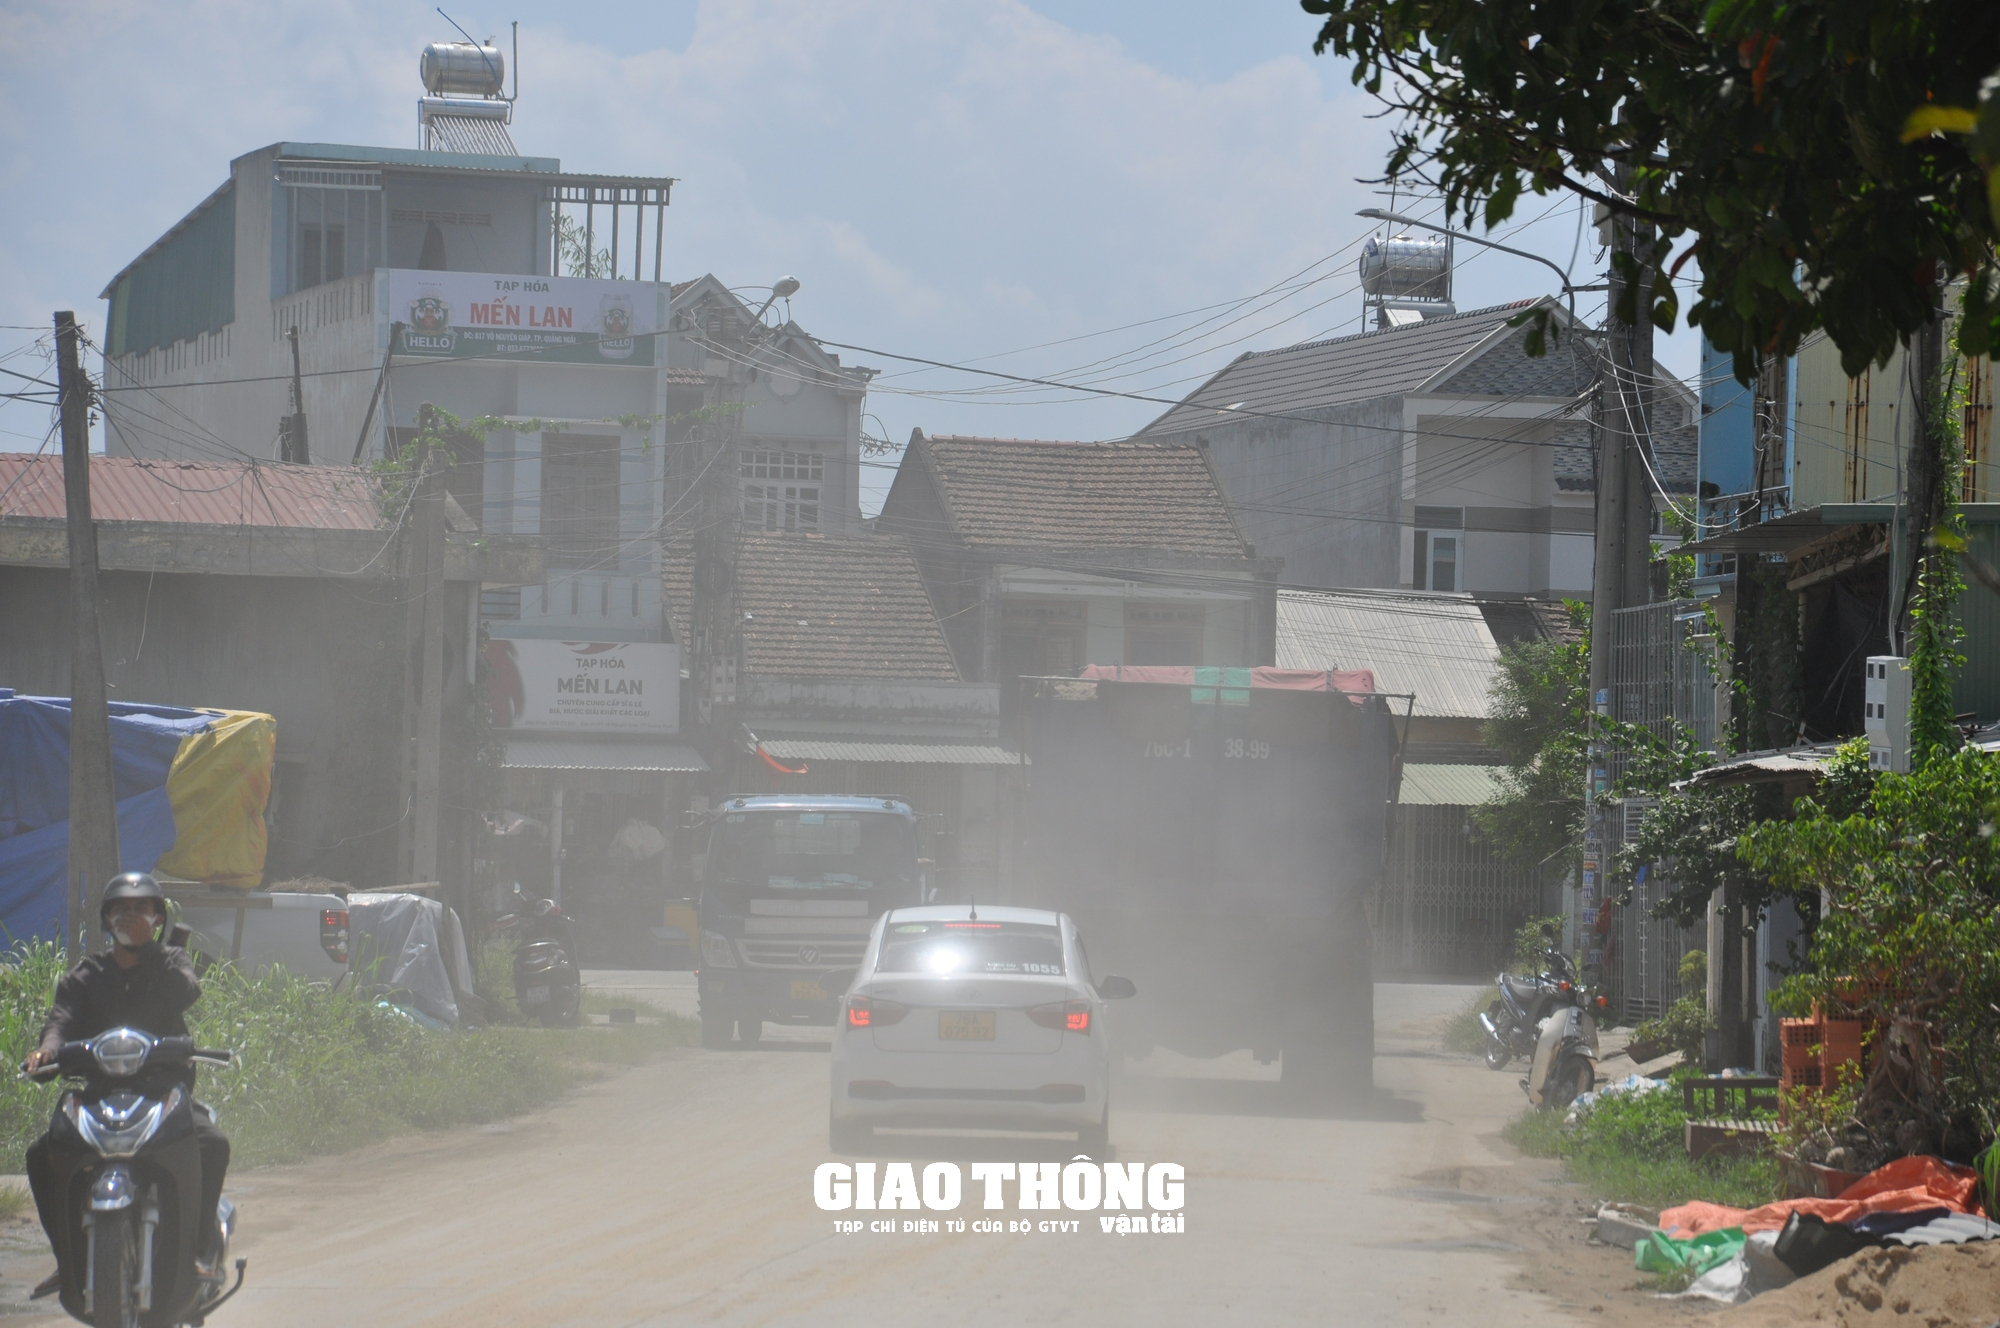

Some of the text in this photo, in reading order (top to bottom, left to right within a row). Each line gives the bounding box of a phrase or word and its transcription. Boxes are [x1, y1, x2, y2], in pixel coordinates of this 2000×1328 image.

[494, 279, 550, 293] TẠP HÓA
[470, 296, 573, 328] MẾN LAN
[409, 336, 450, 349] HELLO
[474, 332, 485, 340] 817
[533, 334, 543, 342] TP.
[544, 333, 562, 343] QUẢNG
[497, 344, 507, 352] ĐT:
[576, 656, 625, 671] TẠP HÓA
[557, 673, 643, 695] MẾN LAN
[557, 698, 585, 706] CHUYÊN
[606, 699, 620, 707] CẤP
[563, 707, 584, 715] NƯỚC
[585, 707, 600, 715] GIẢI
[619, 708, 633, 716] CÁC
[634, 709, 650, 718] LOẠI
[1224, 738, 1270, 760] 38.99
[1022, 962, 1061, 976] 1055
